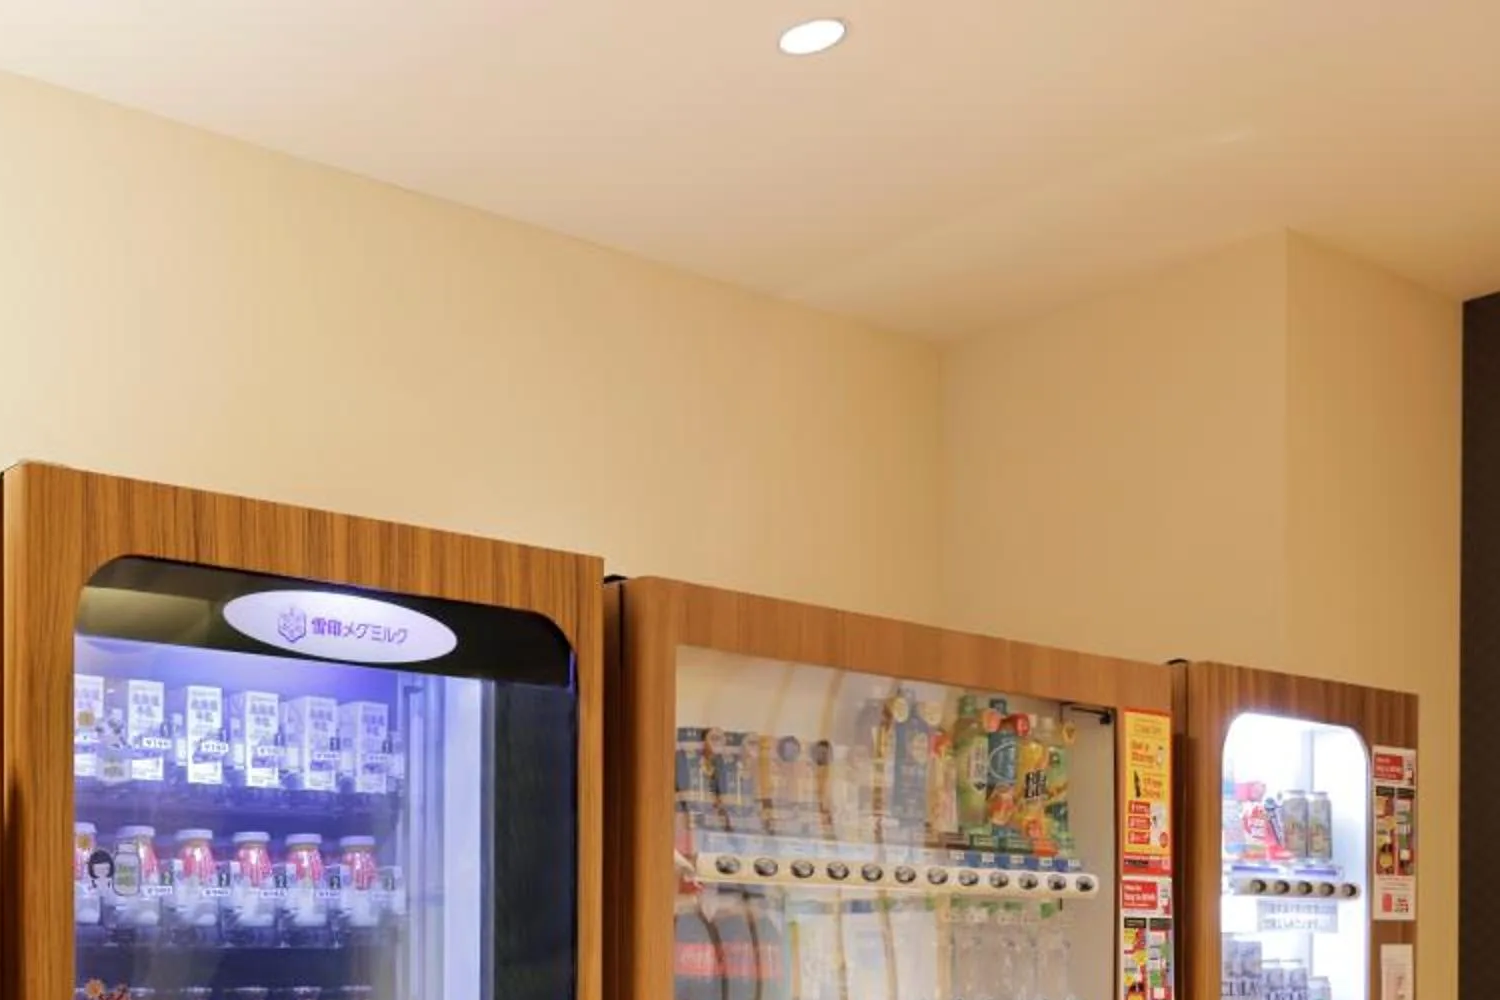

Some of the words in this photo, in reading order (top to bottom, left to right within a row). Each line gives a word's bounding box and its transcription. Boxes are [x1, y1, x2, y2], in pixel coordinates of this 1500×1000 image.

[311, 616, 409, 646] 雪印メグミルク
